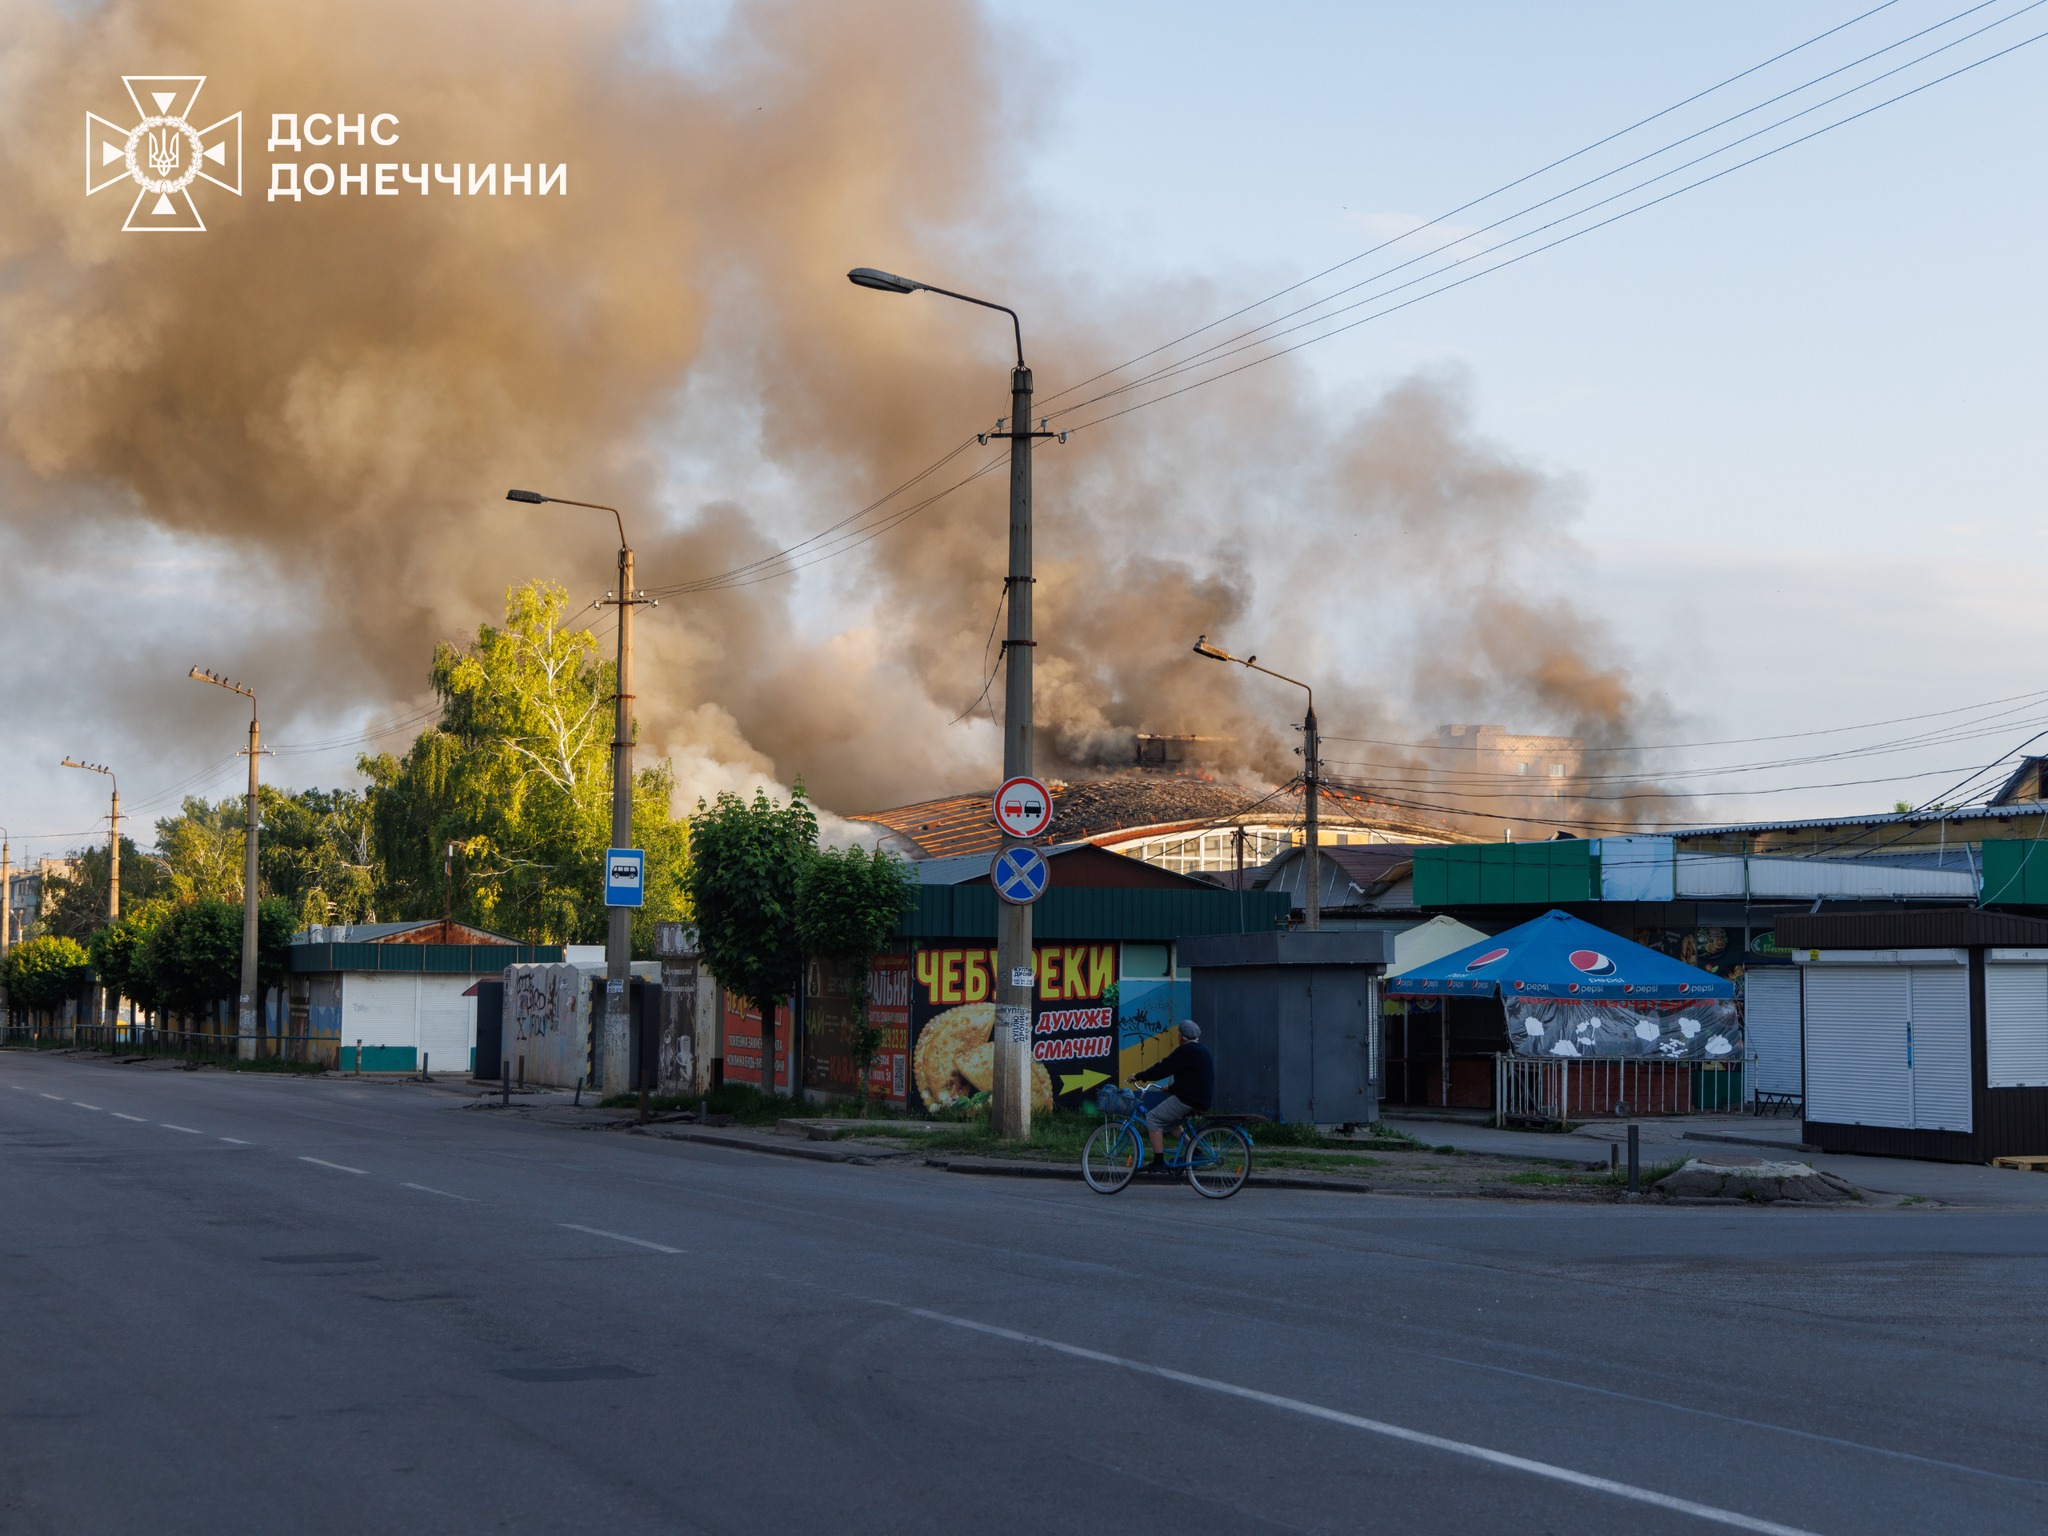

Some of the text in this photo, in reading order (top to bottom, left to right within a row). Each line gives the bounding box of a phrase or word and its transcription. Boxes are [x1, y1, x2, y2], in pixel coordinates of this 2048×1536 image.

[916, 945, 1116, 1004] ЧЕБЕКИ
[1526, 982, 1549, 992] pepsi
[867, 970, 908, 1007] РАЛЬНЯ
[1581, 984, 1604, 994] pepsi
[1635, 984, 1658, 994] pepsi
[1691, 983, 1714, 993] pepsi
[805, 1007, 825, 1036] ЧАЙ
[1012, 1015, 1020, 1043] КУПЛЮ
[1034, 1007, 1113, 1034] ДУУУЖЕ
[1033, 1036, 1112, 1061] СМАЧНІ!
